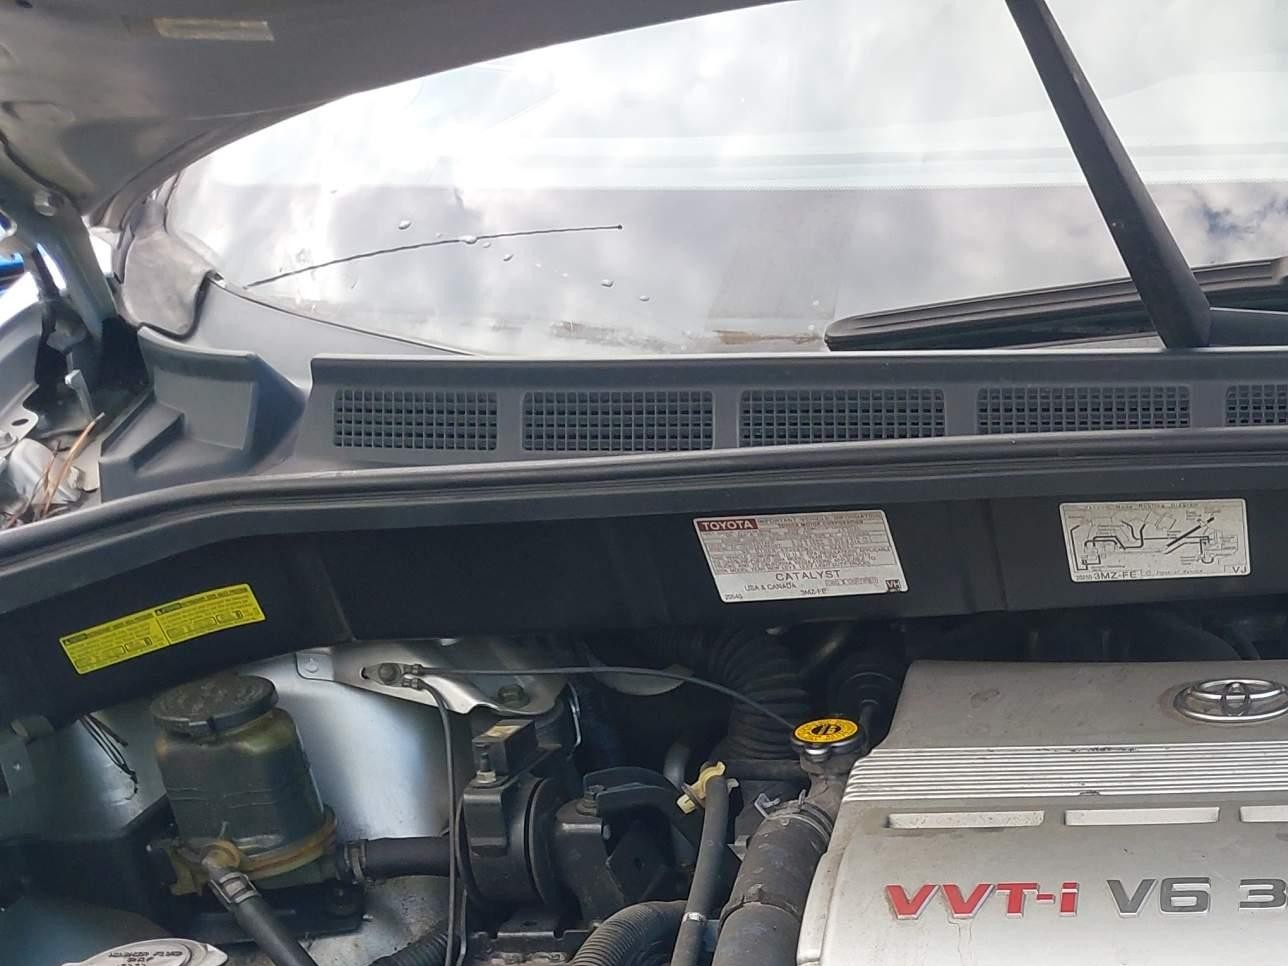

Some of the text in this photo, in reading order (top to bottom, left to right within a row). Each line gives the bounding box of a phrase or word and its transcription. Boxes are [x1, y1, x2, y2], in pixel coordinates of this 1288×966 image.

[701, 519, 754, 531] TOYOTA
[775, 569, 841, 582] CATALYST
[1093, 570, 1138, 580] 3MZ-FE
[1232, 566, 1247, 574] VJ
[885, 882, 1080, 920] VVT-i
[1106, 877, 1212, 918] V6
